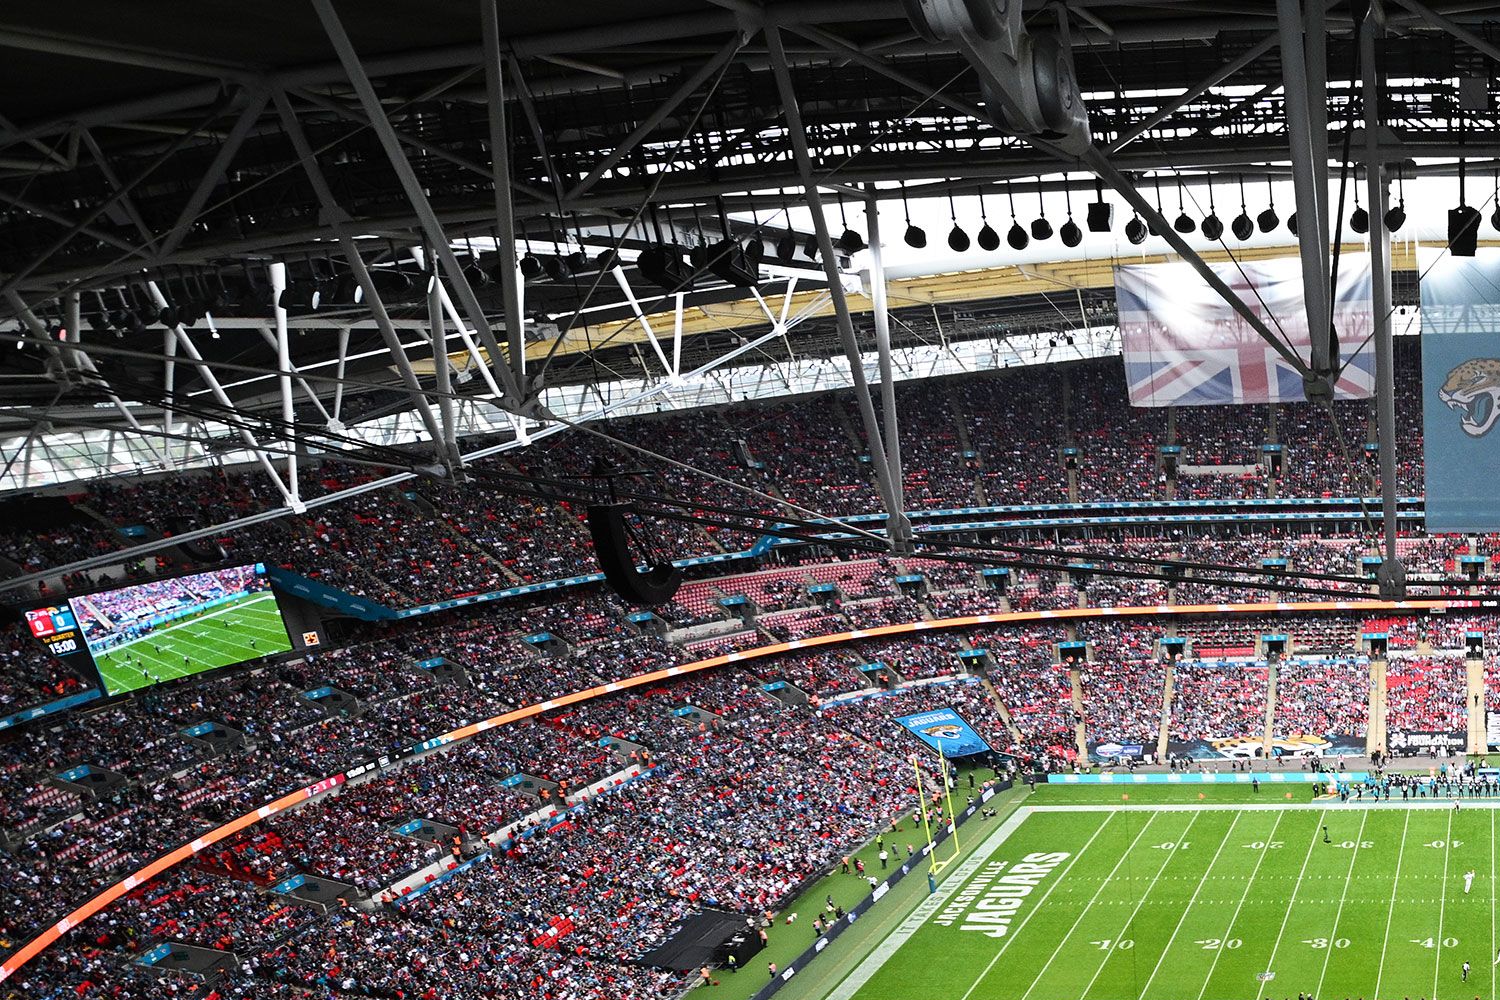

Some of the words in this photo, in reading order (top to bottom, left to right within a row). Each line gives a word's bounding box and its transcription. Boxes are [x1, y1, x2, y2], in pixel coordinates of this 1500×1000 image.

[49, 639, 76, 654] 15:00
[1160, 841, 1191, 850] 10
[1250, 841, 1284, 850] 20
[1341, 841, 1374, 850] 30
[1431, 840, 1464, 849] 40
[933, 860, 1009, 927] JACKSONVILLE
[960, 852, 1071, 938] JAGUARS
[1098, 939, 1135, 950] 10
[1202, 939, 1243, 950] 20
[1311, 938, 1351, 949] 30
[1419, 937, 1459, 948] 40
